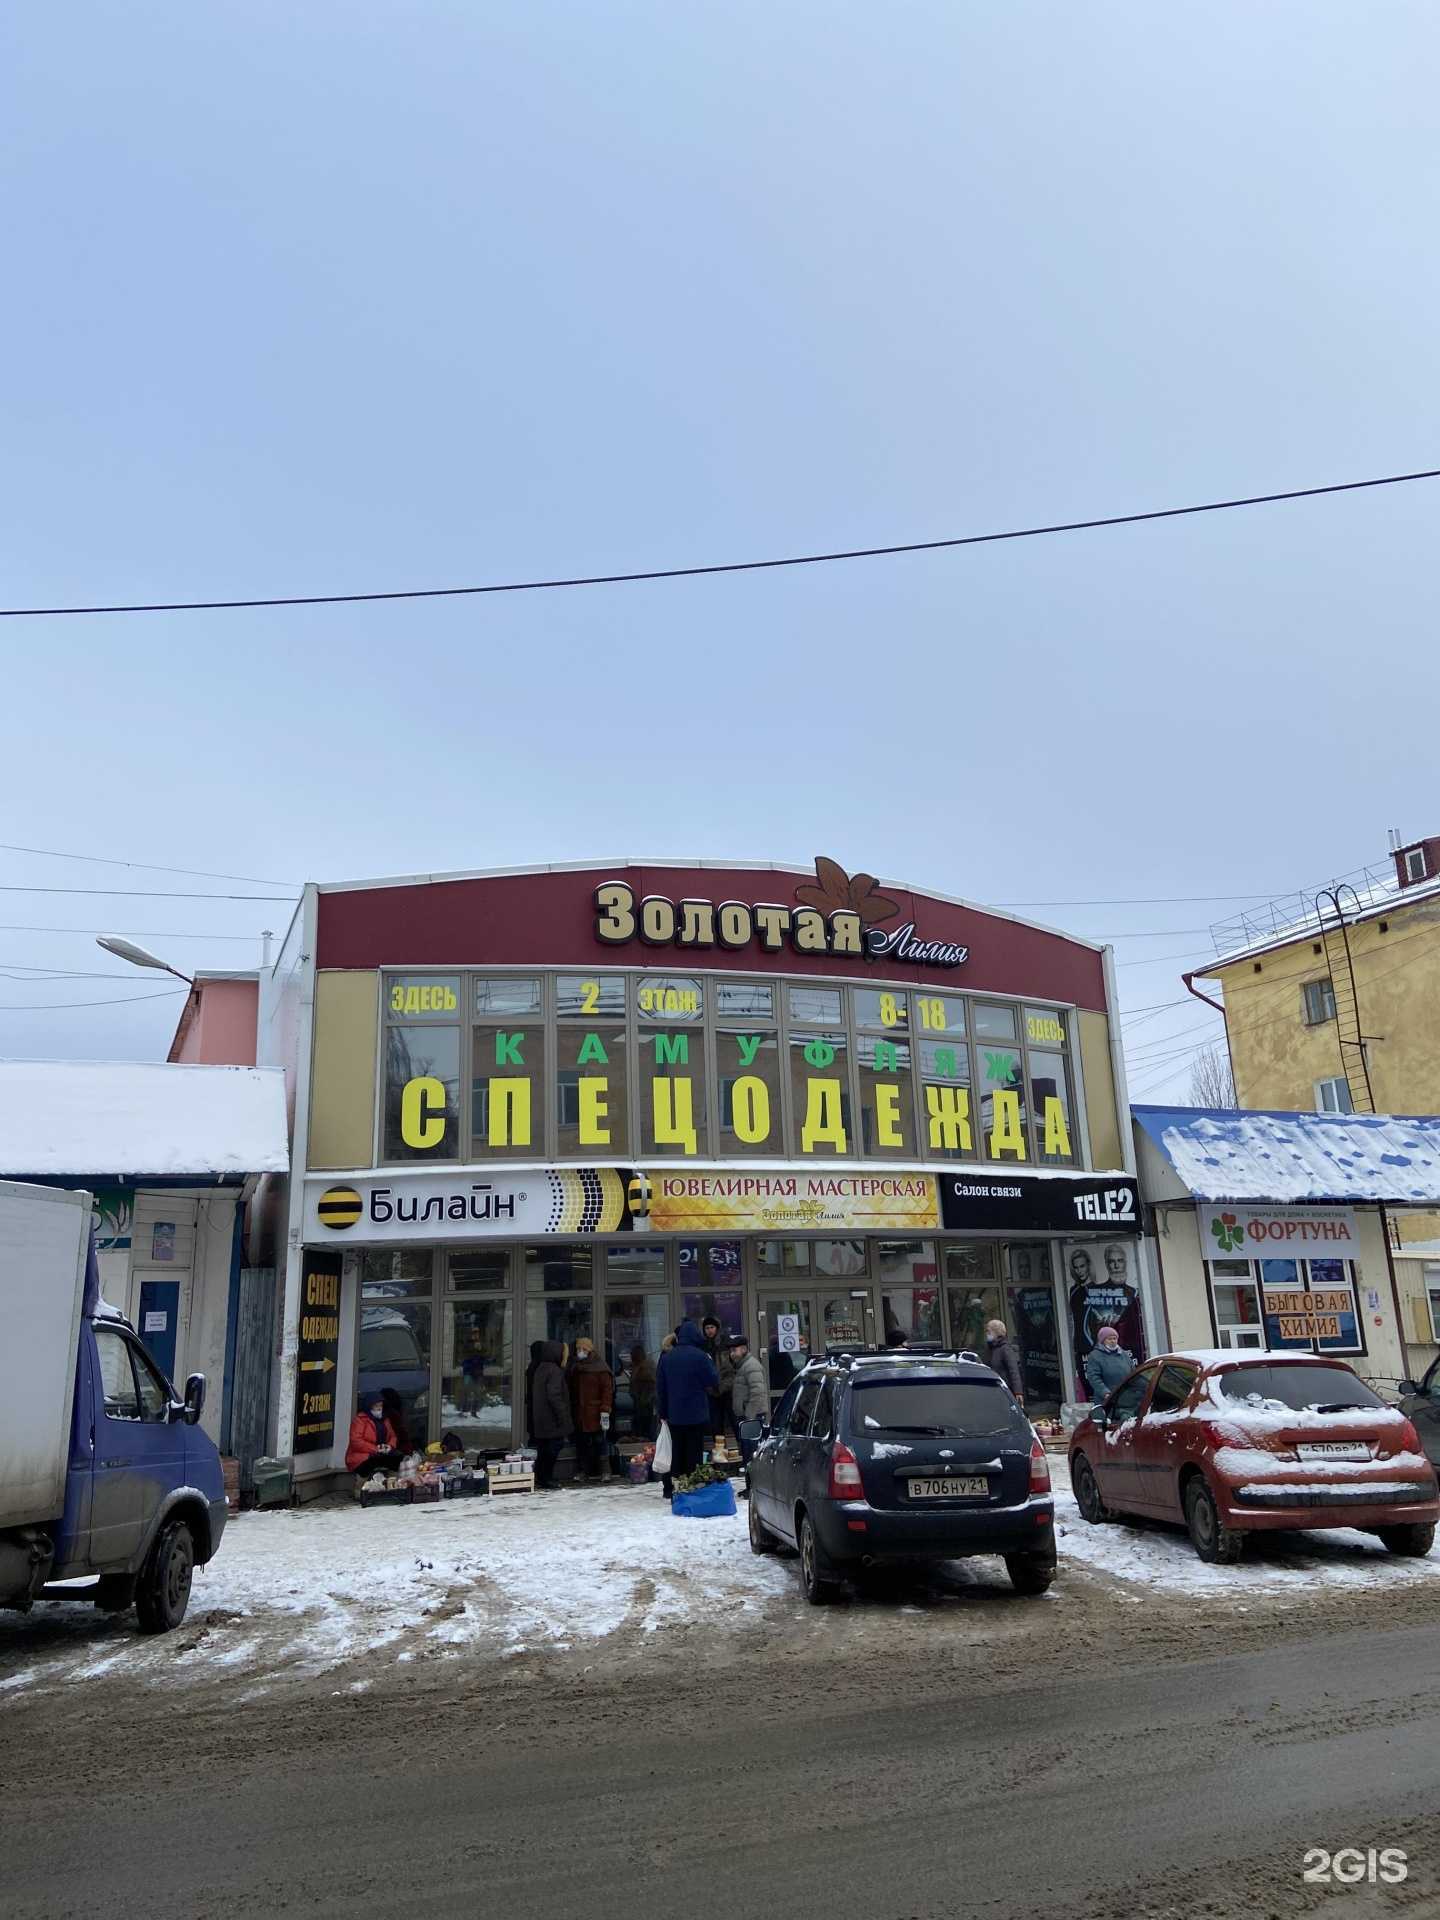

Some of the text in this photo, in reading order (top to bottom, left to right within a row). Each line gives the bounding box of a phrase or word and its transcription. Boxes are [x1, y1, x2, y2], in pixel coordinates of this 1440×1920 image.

[597, 885, 969, 964] Золотая Лилия
[391, 985, 457, 1015] ЗДЕСЬ
[580, 982, 601, 1015] 2
[639, 988, 698, 1013] ЭТАЖ
[1026, 1016, 1065, 1042] ЗДЕСЬ
[401, 1076, 1073, 1160] СПЕЦОДЕЖДА
[662, 1178, 927, 1197] ЮВЕЛИРНАЯ МАСТЕРСКАЯ
[953, 1182, 1022, 1198] Салон связи
[369, 1184, 516, 1223] Билайн
[1073, 1187, 1136, 1221] TELE2
[1246, 1218, 1352, 1242] ФОРТУНА
[306, 1273, 338, 1311] СПЕЦ
[1267, 1292, 1349, 1313] БЫТОВАЯ
[302, 1316, 338, 1344] ОДЕЖДА
[1281, 1317, 1339, 1337] ХИМИЯ
